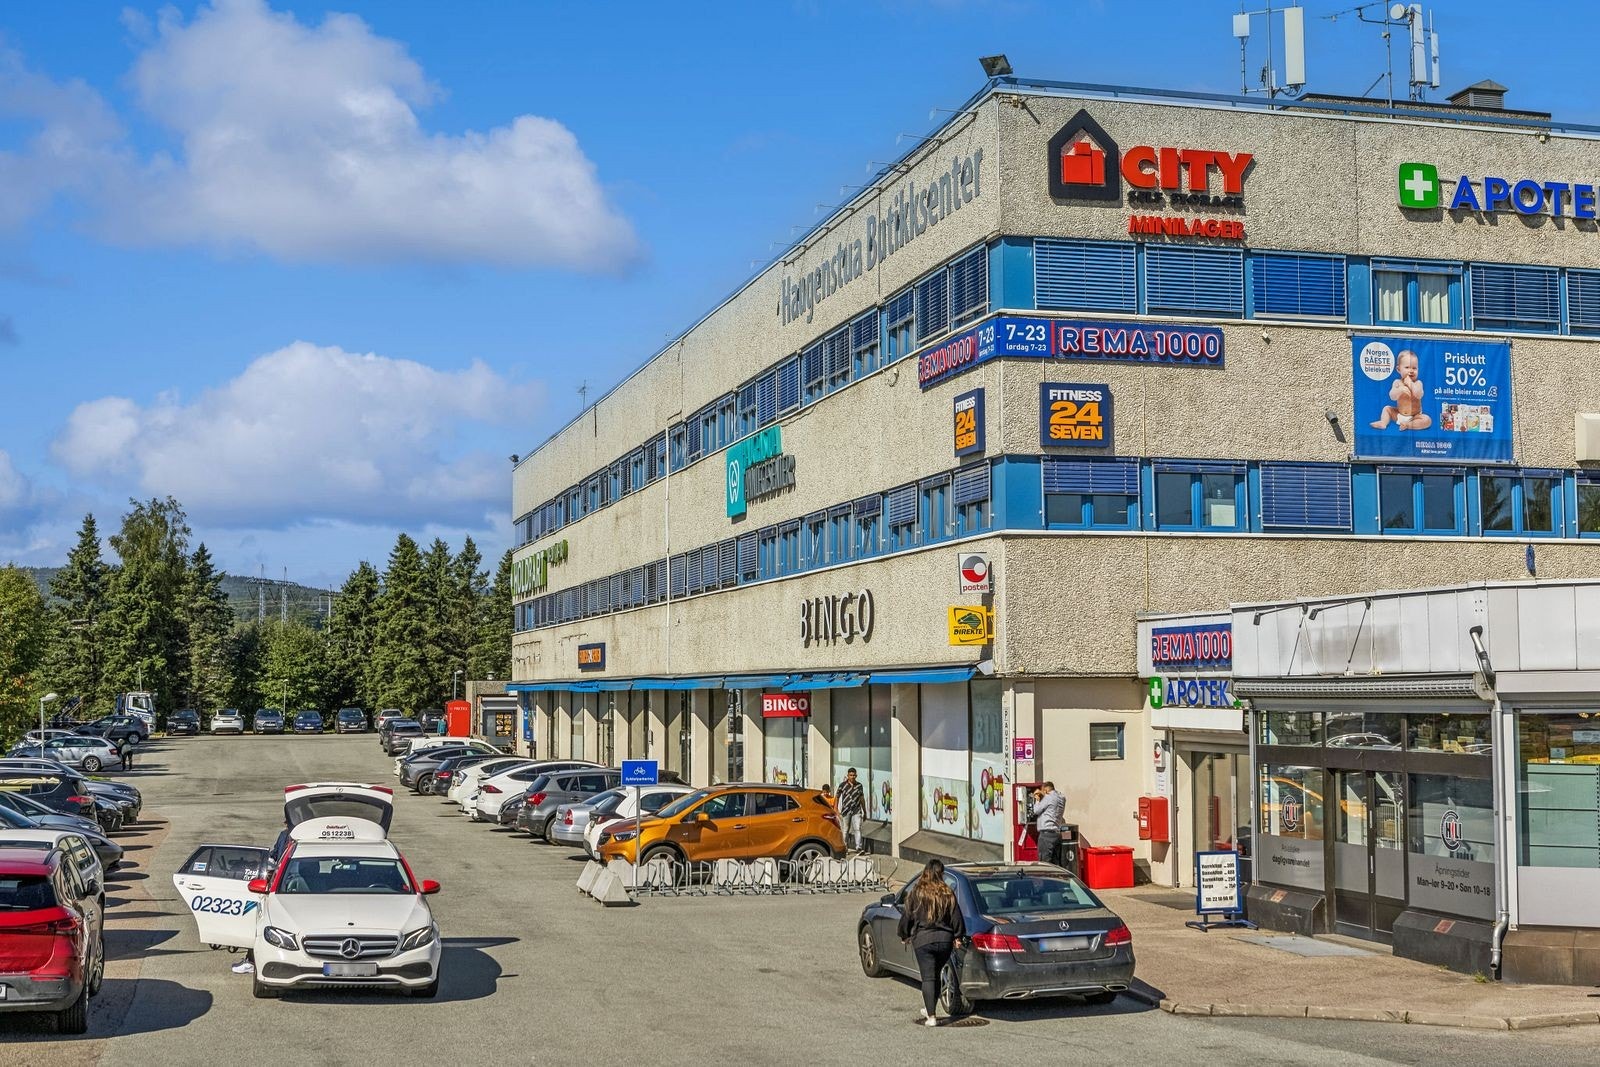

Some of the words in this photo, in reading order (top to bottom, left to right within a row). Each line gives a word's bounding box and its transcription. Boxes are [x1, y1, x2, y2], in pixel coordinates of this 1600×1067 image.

[1121, 145, 1253, 194] CITY
[1170, 192, 1244, 208] STORAGE
[1450, 175, 1600, 219] APOTE
[781, 238, 862, 326] Haugenstua
[866, 147, 983, 271] Butikksenter
[1128, 215, 1245, 240] MINILAGER
[978, 325, 995, 346] 7-23
[1006, 324, 1046, 341] 7-23
[1060, 326, 1148, 354] REMA
[1155, 331, 1220, 358] 1000
[1006, 343, 1029, 352] lørdag
[1366, 348, 1389, 357] Norges
[918, 347, 946, 382] REMA
[946, 336, 973, 369] 1000
[1444, 352, 1486, 365] Priskutt
[1445, 367, 1487, 386] 50%
[1049, 389, 1102, 402] FITNESS
[1434, 387, 1442, 395] på
[955, 408, 976, 436] 24
[1049, 401, 1103, 426] 24
[1049, 425, 1103, 440] SEVEN
[962, 584, 988, 592] posten
[800, 588, 874, 643] BINGO
[1151, 632, 1195, 660] REMA
[1195, 630, 1232, 660] 1000
[1166, 680, 1230, 706] APOTEK
[763, 698, 808, 712] BINGO
[191, 895, 243, 916] 02323
